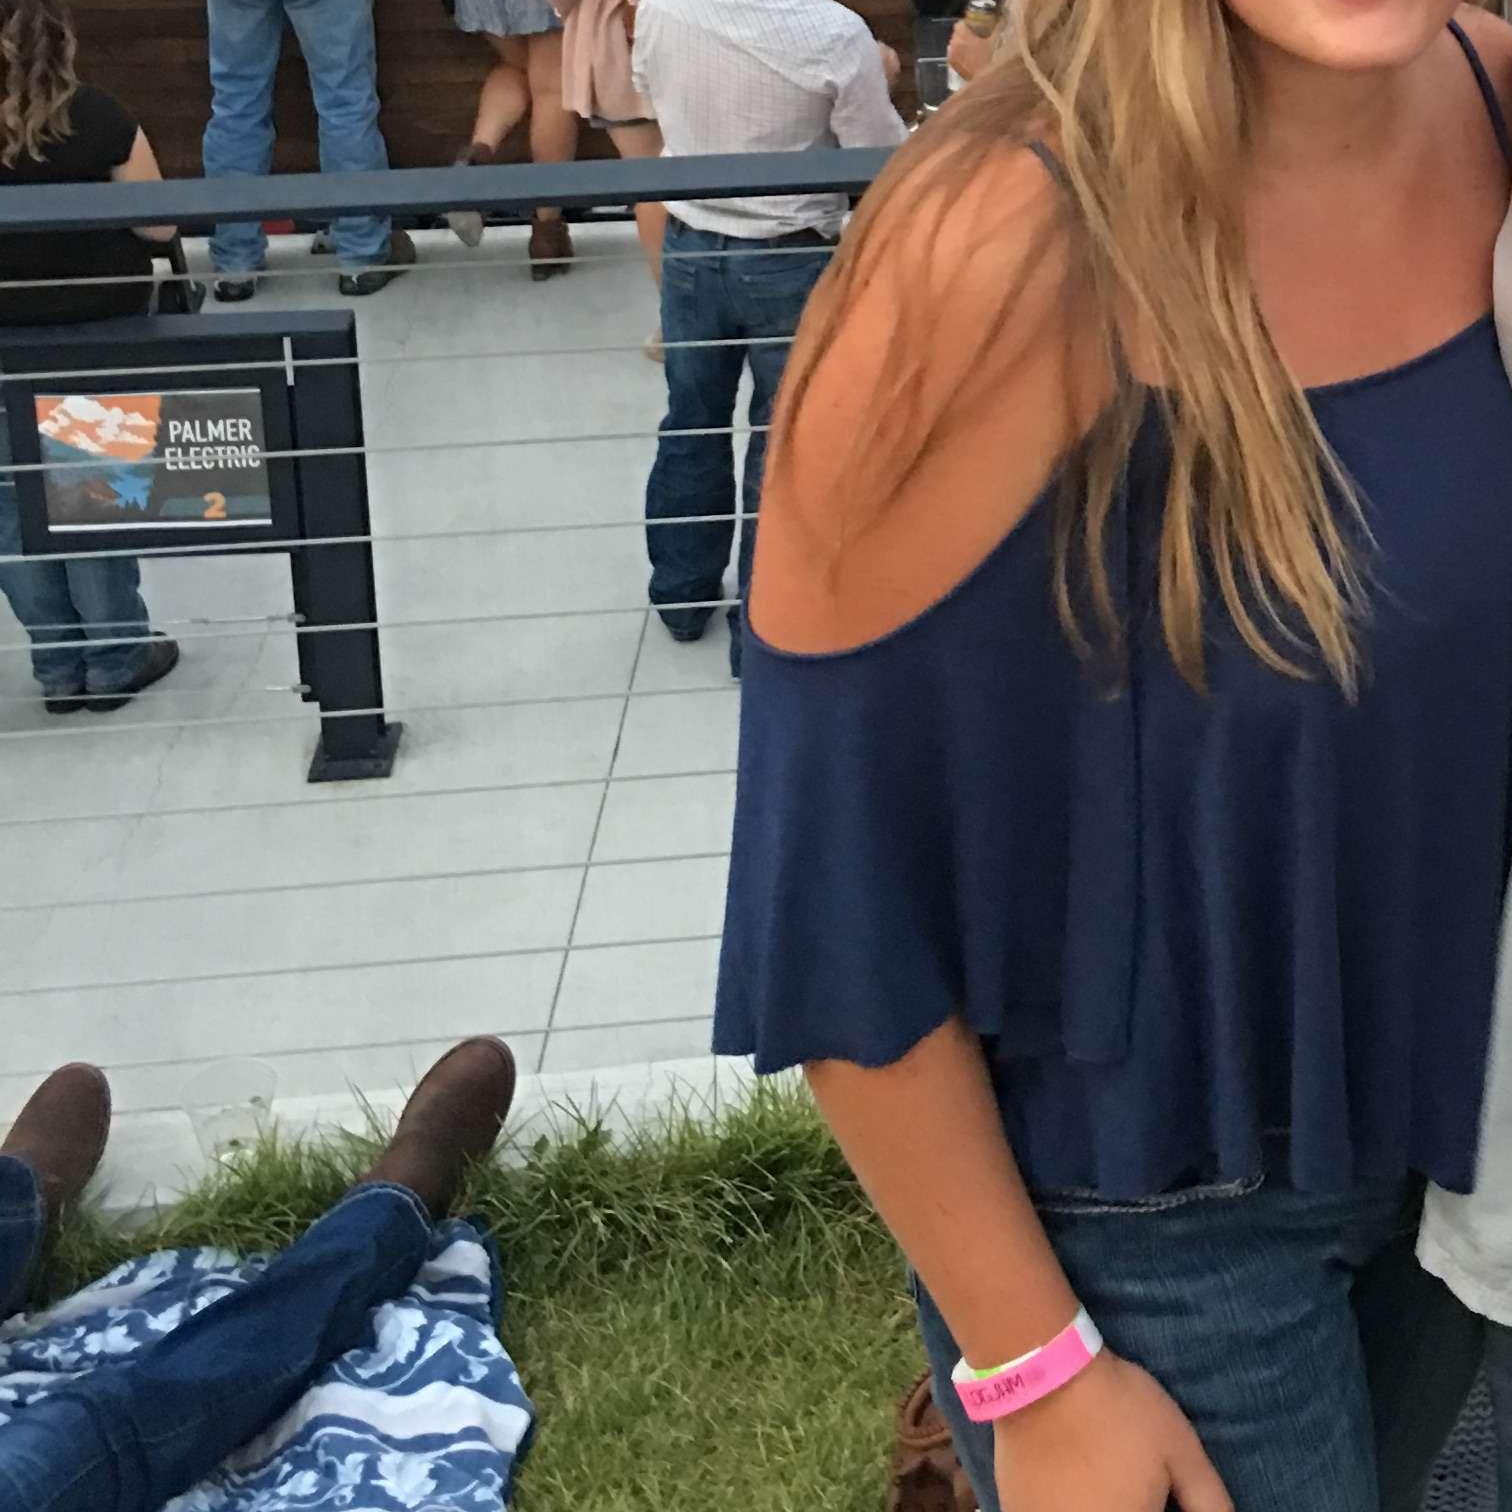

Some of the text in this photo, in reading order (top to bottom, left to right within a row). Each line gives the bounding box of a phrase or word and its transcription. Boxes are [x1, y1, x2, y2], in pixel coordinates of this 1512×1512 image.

[169, 418, 252, 443] PALMER
[165, 444, 262, 471] ELECTRIC
[203, 492, 227, 518] 2
